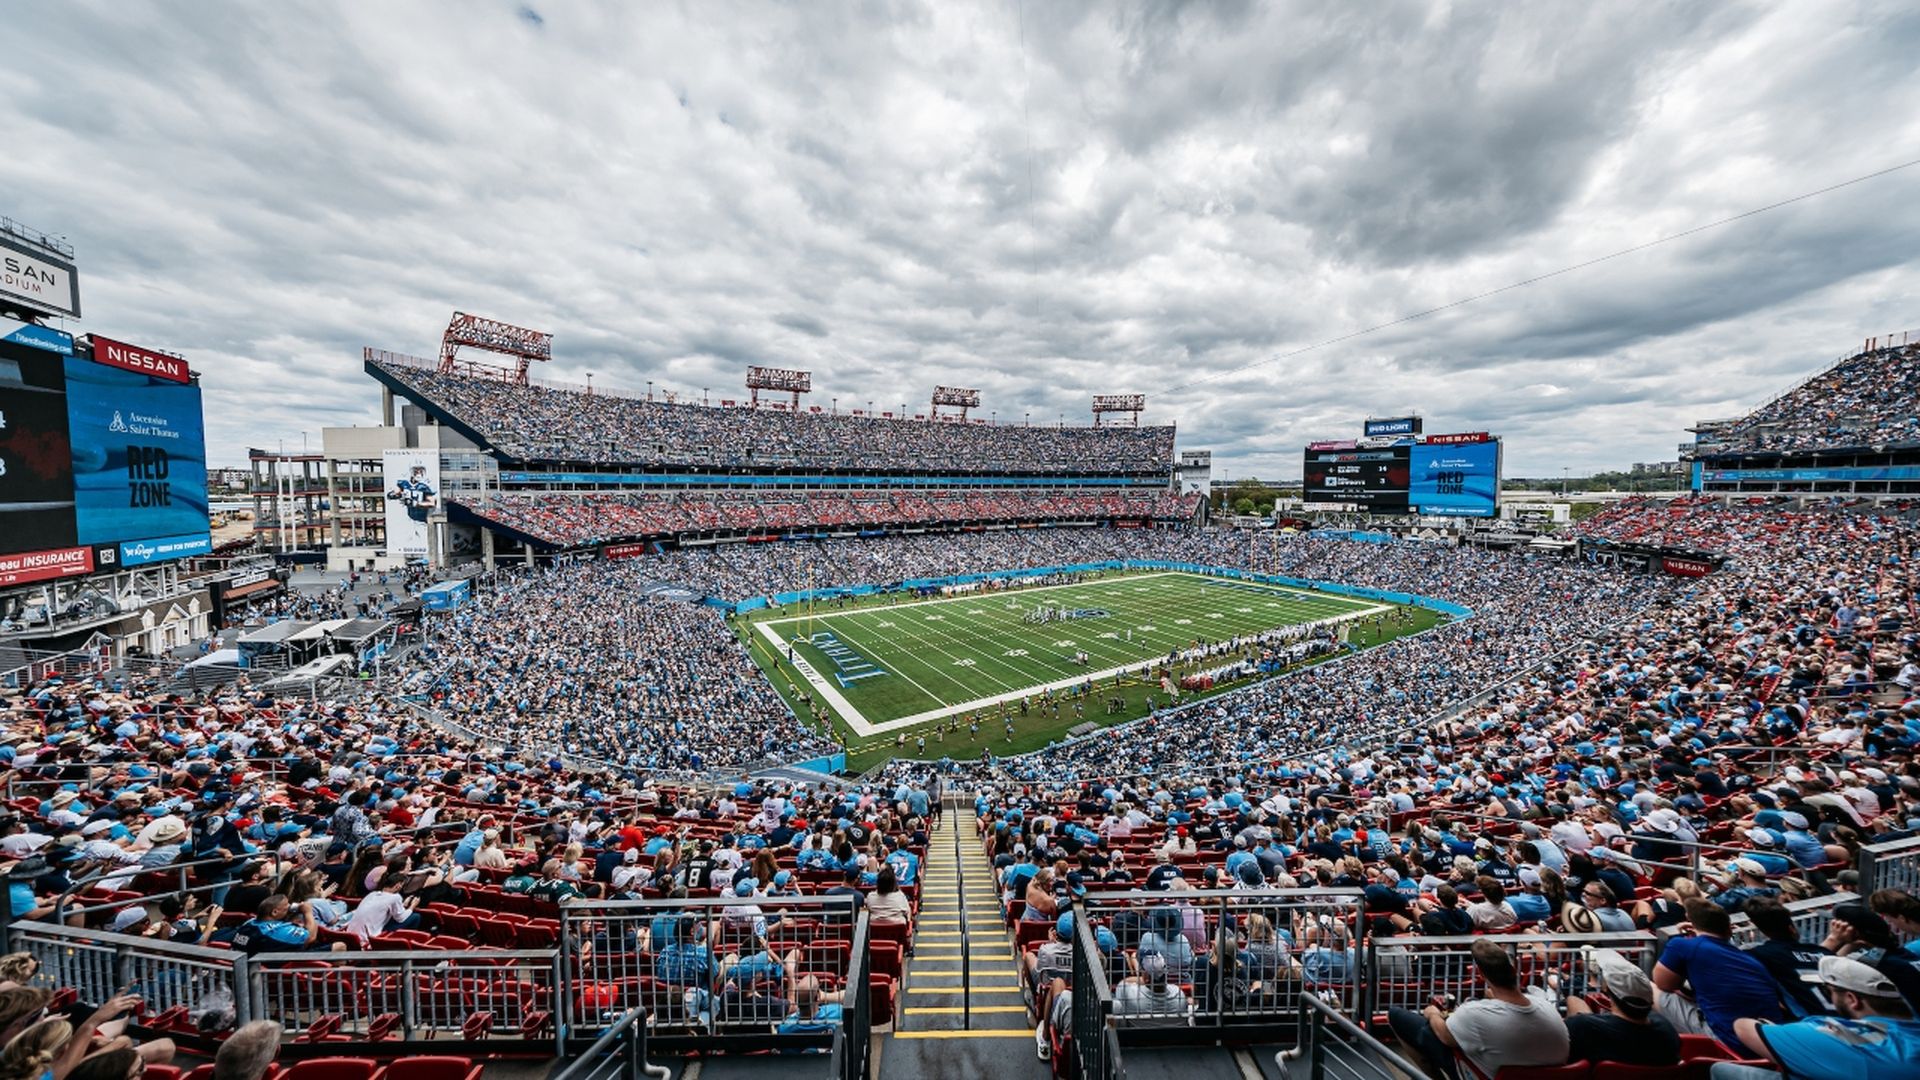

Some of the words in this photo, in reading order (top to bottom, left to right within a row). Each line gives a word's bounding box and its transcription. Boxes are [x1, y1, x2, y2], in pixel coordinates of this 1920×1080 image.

[107, 345, 179, 376] NISSAN
[130, 412, 168, 426] Ascension
[130, 424, 150, 436] Saint
[151, 427, 179, 439] Thomas
[1386, 423, 1409, 431] LIGHT
[1433, 434, 1480, 443] NISSAN
[127, 445, 169, 480] RED
[1437, 471, 1464, 484] RED
[129, 481, 171, 508] ZONE
[1437, 484, 1464, 495] ZONE
[23, 550, 85, 567] INSURANCE
[1667, 560, 1705, 572] NISSAN
[688, 868, 701, 888] 8
